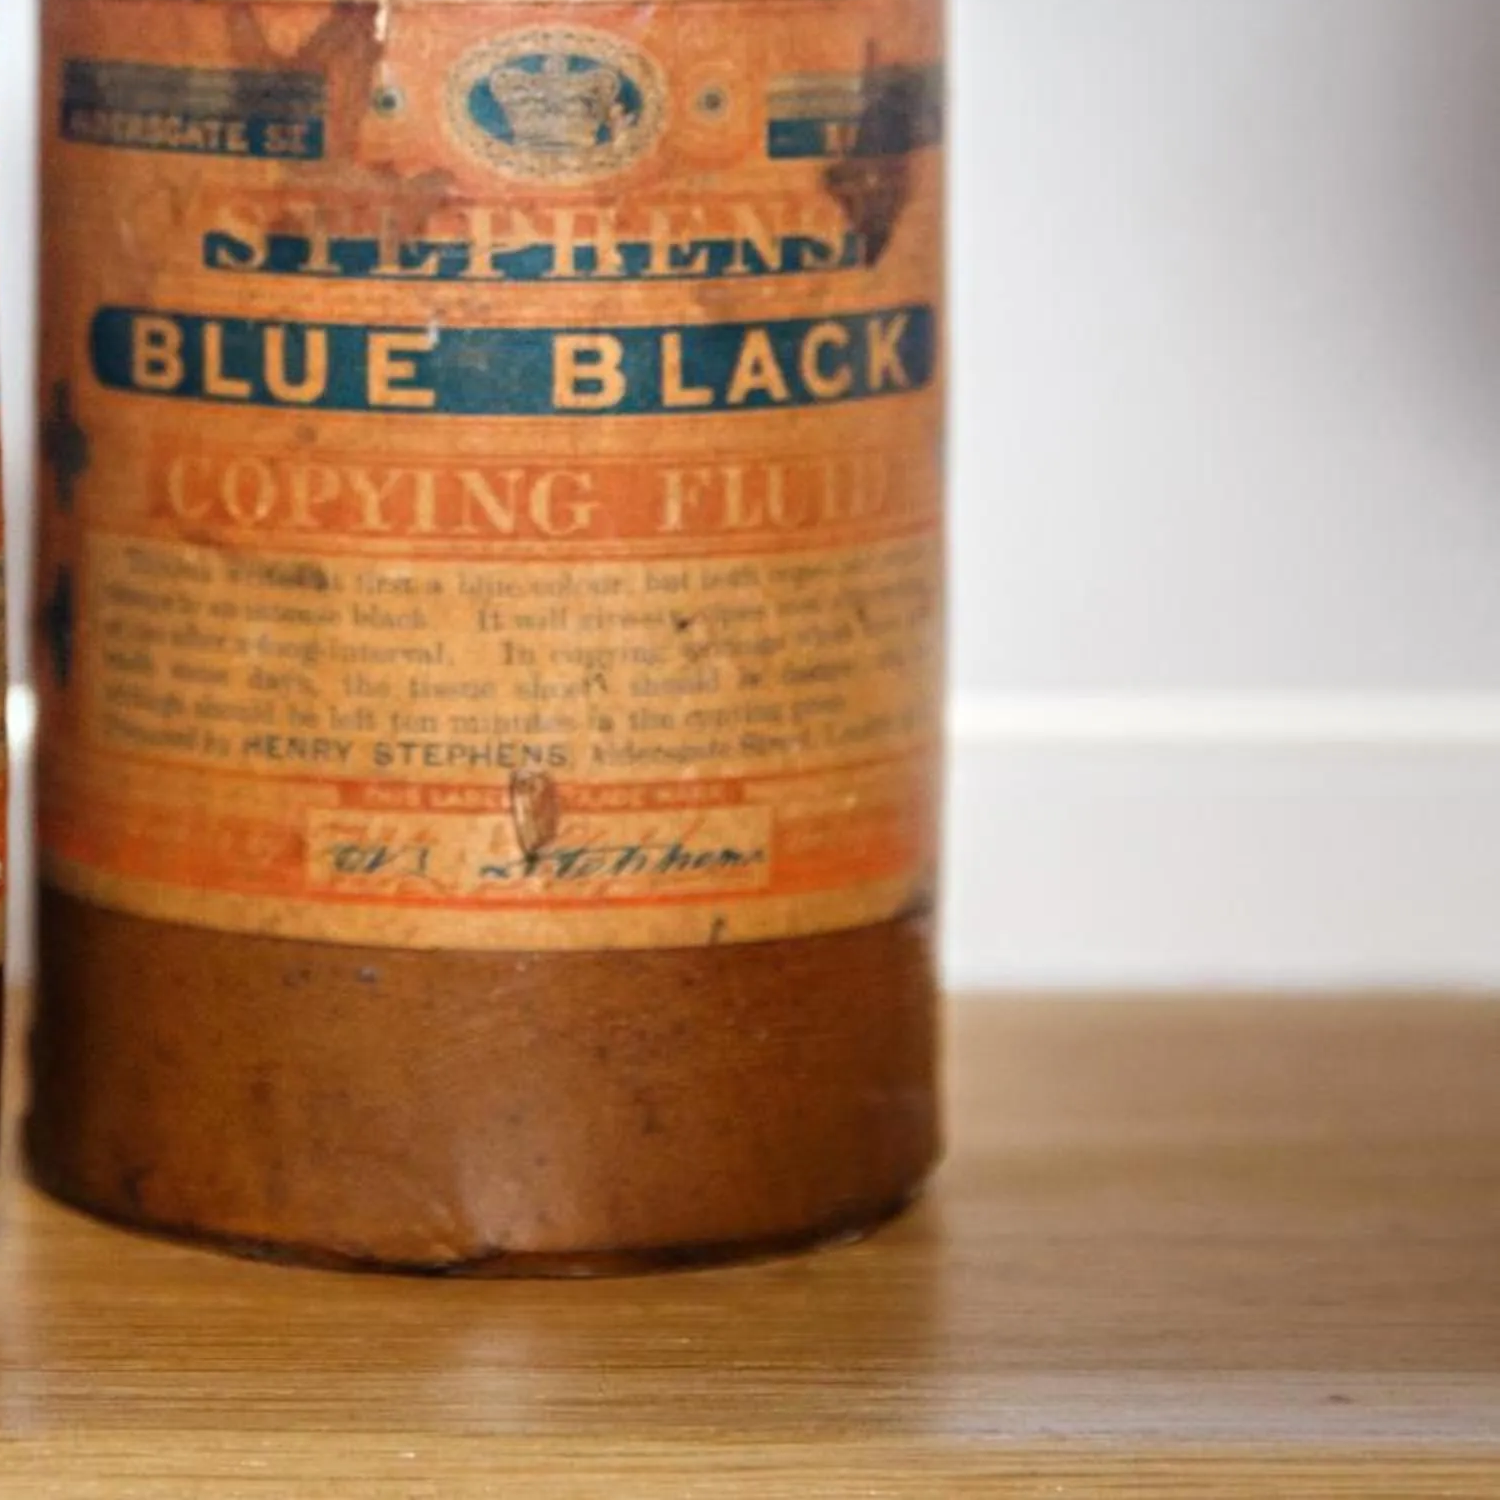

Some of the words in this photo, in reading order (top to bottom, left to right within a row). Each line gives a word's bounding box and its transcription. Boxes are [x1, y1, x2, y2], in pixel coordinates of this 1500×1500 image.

[131, 314, 435, 408] BLUE
[551, 315, 910, 408] BLACK
[167, 457, 599, 537] COPYING
[656, 450, 887, 532] FLUID
[243, 734, 353, 762] HENRY
